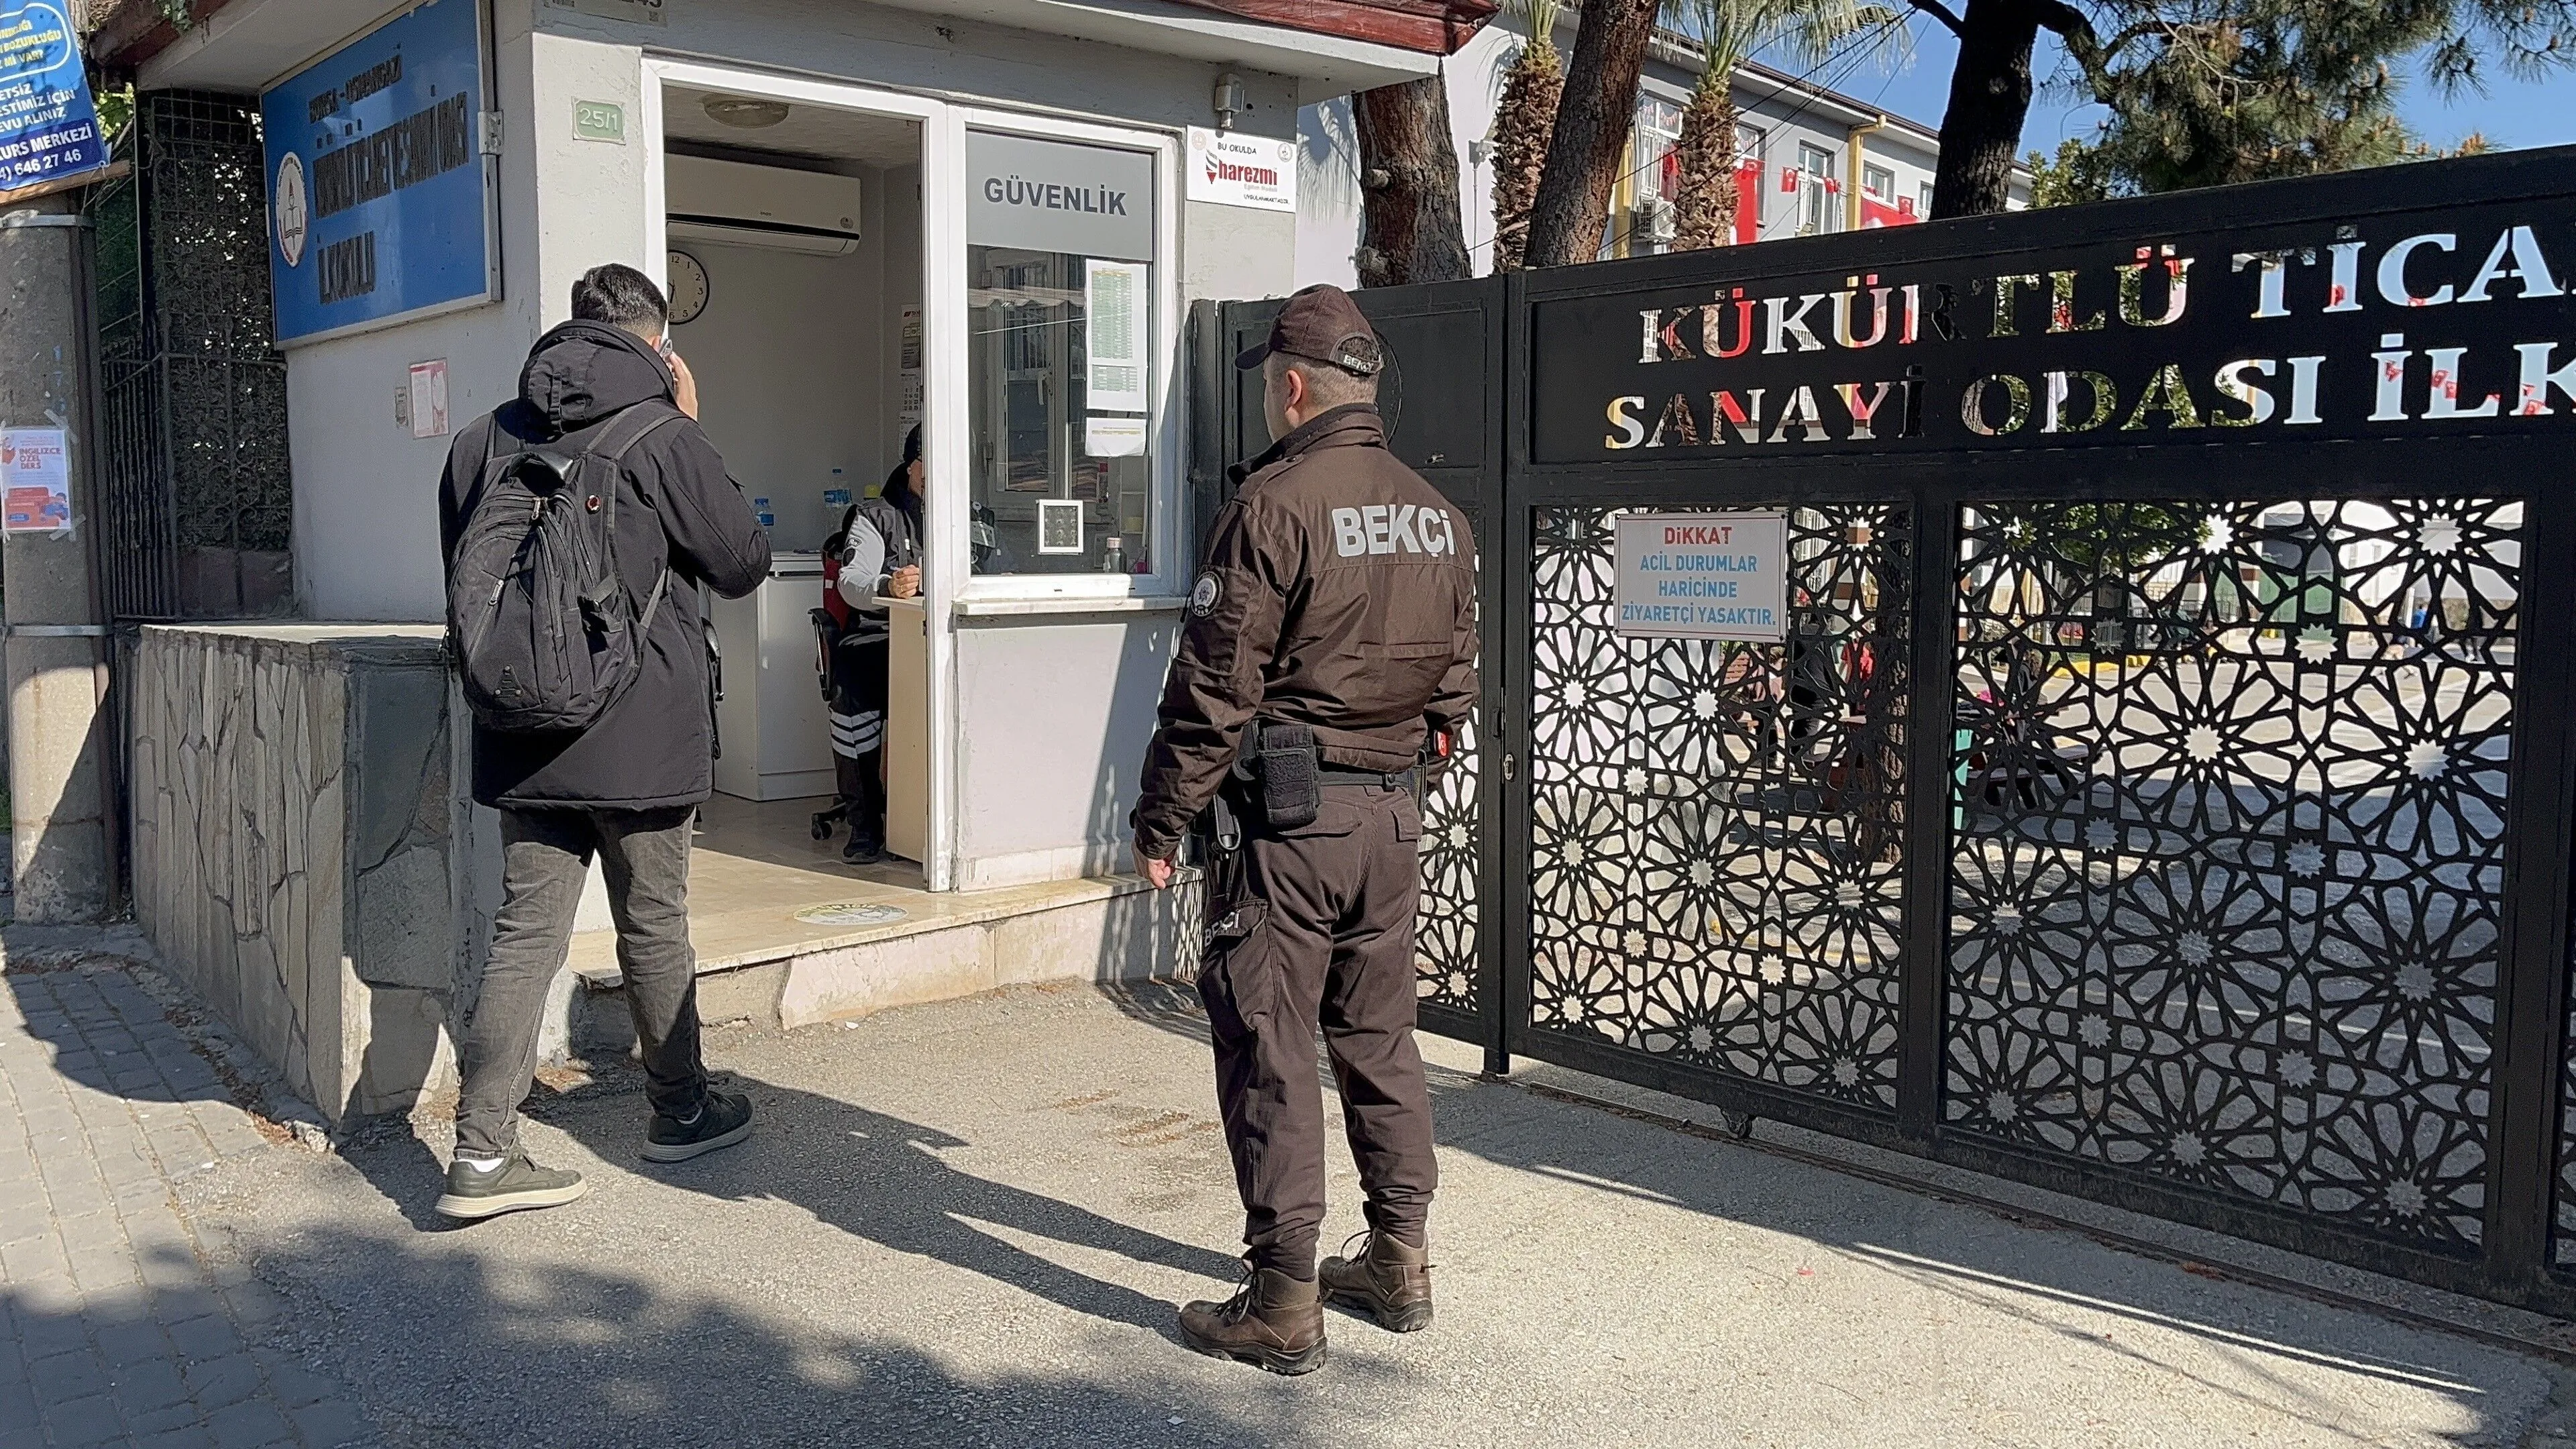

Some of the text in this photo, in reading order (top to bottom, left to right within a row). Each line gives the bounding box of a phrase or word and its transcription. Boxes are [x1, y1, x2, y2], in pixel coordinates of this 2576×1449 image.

[46, 89, 76, 105] İÇİN
[24, 107, 66, 126] ALINIZ
[579, 108, 619, 131] 25/1
[30, 123, 93, 152] MERKEZİ
[1218, 142, 1257, 155] BU OKULDA
[14, 158, 41, 176] 646
[43, 154, 59, 170] 27
[64, 148, 82, 164] 46
[1219, 159, 1277, 185] harezmi
[984, 174, 1127, 216] GÜVENLİK
[1638, 225, 2576, 363] KÜKÜRTLÜ TİCA
[669, 311, 674, 319] 6
[1604, 332, 2576, 449] SANAYİ ODASI İLK
[1332, 504, 1455, 557] BEKÇİ
[1664, 527, 1732, 545] DİKKAT
[1640, 550, 1758, 572] ACİL DURUMLAR
[1658, 576, 1737, 598] HARİCİNDE
[1621, 600, 1776, 625] ZİYARETÇİ YASAKTIR.
